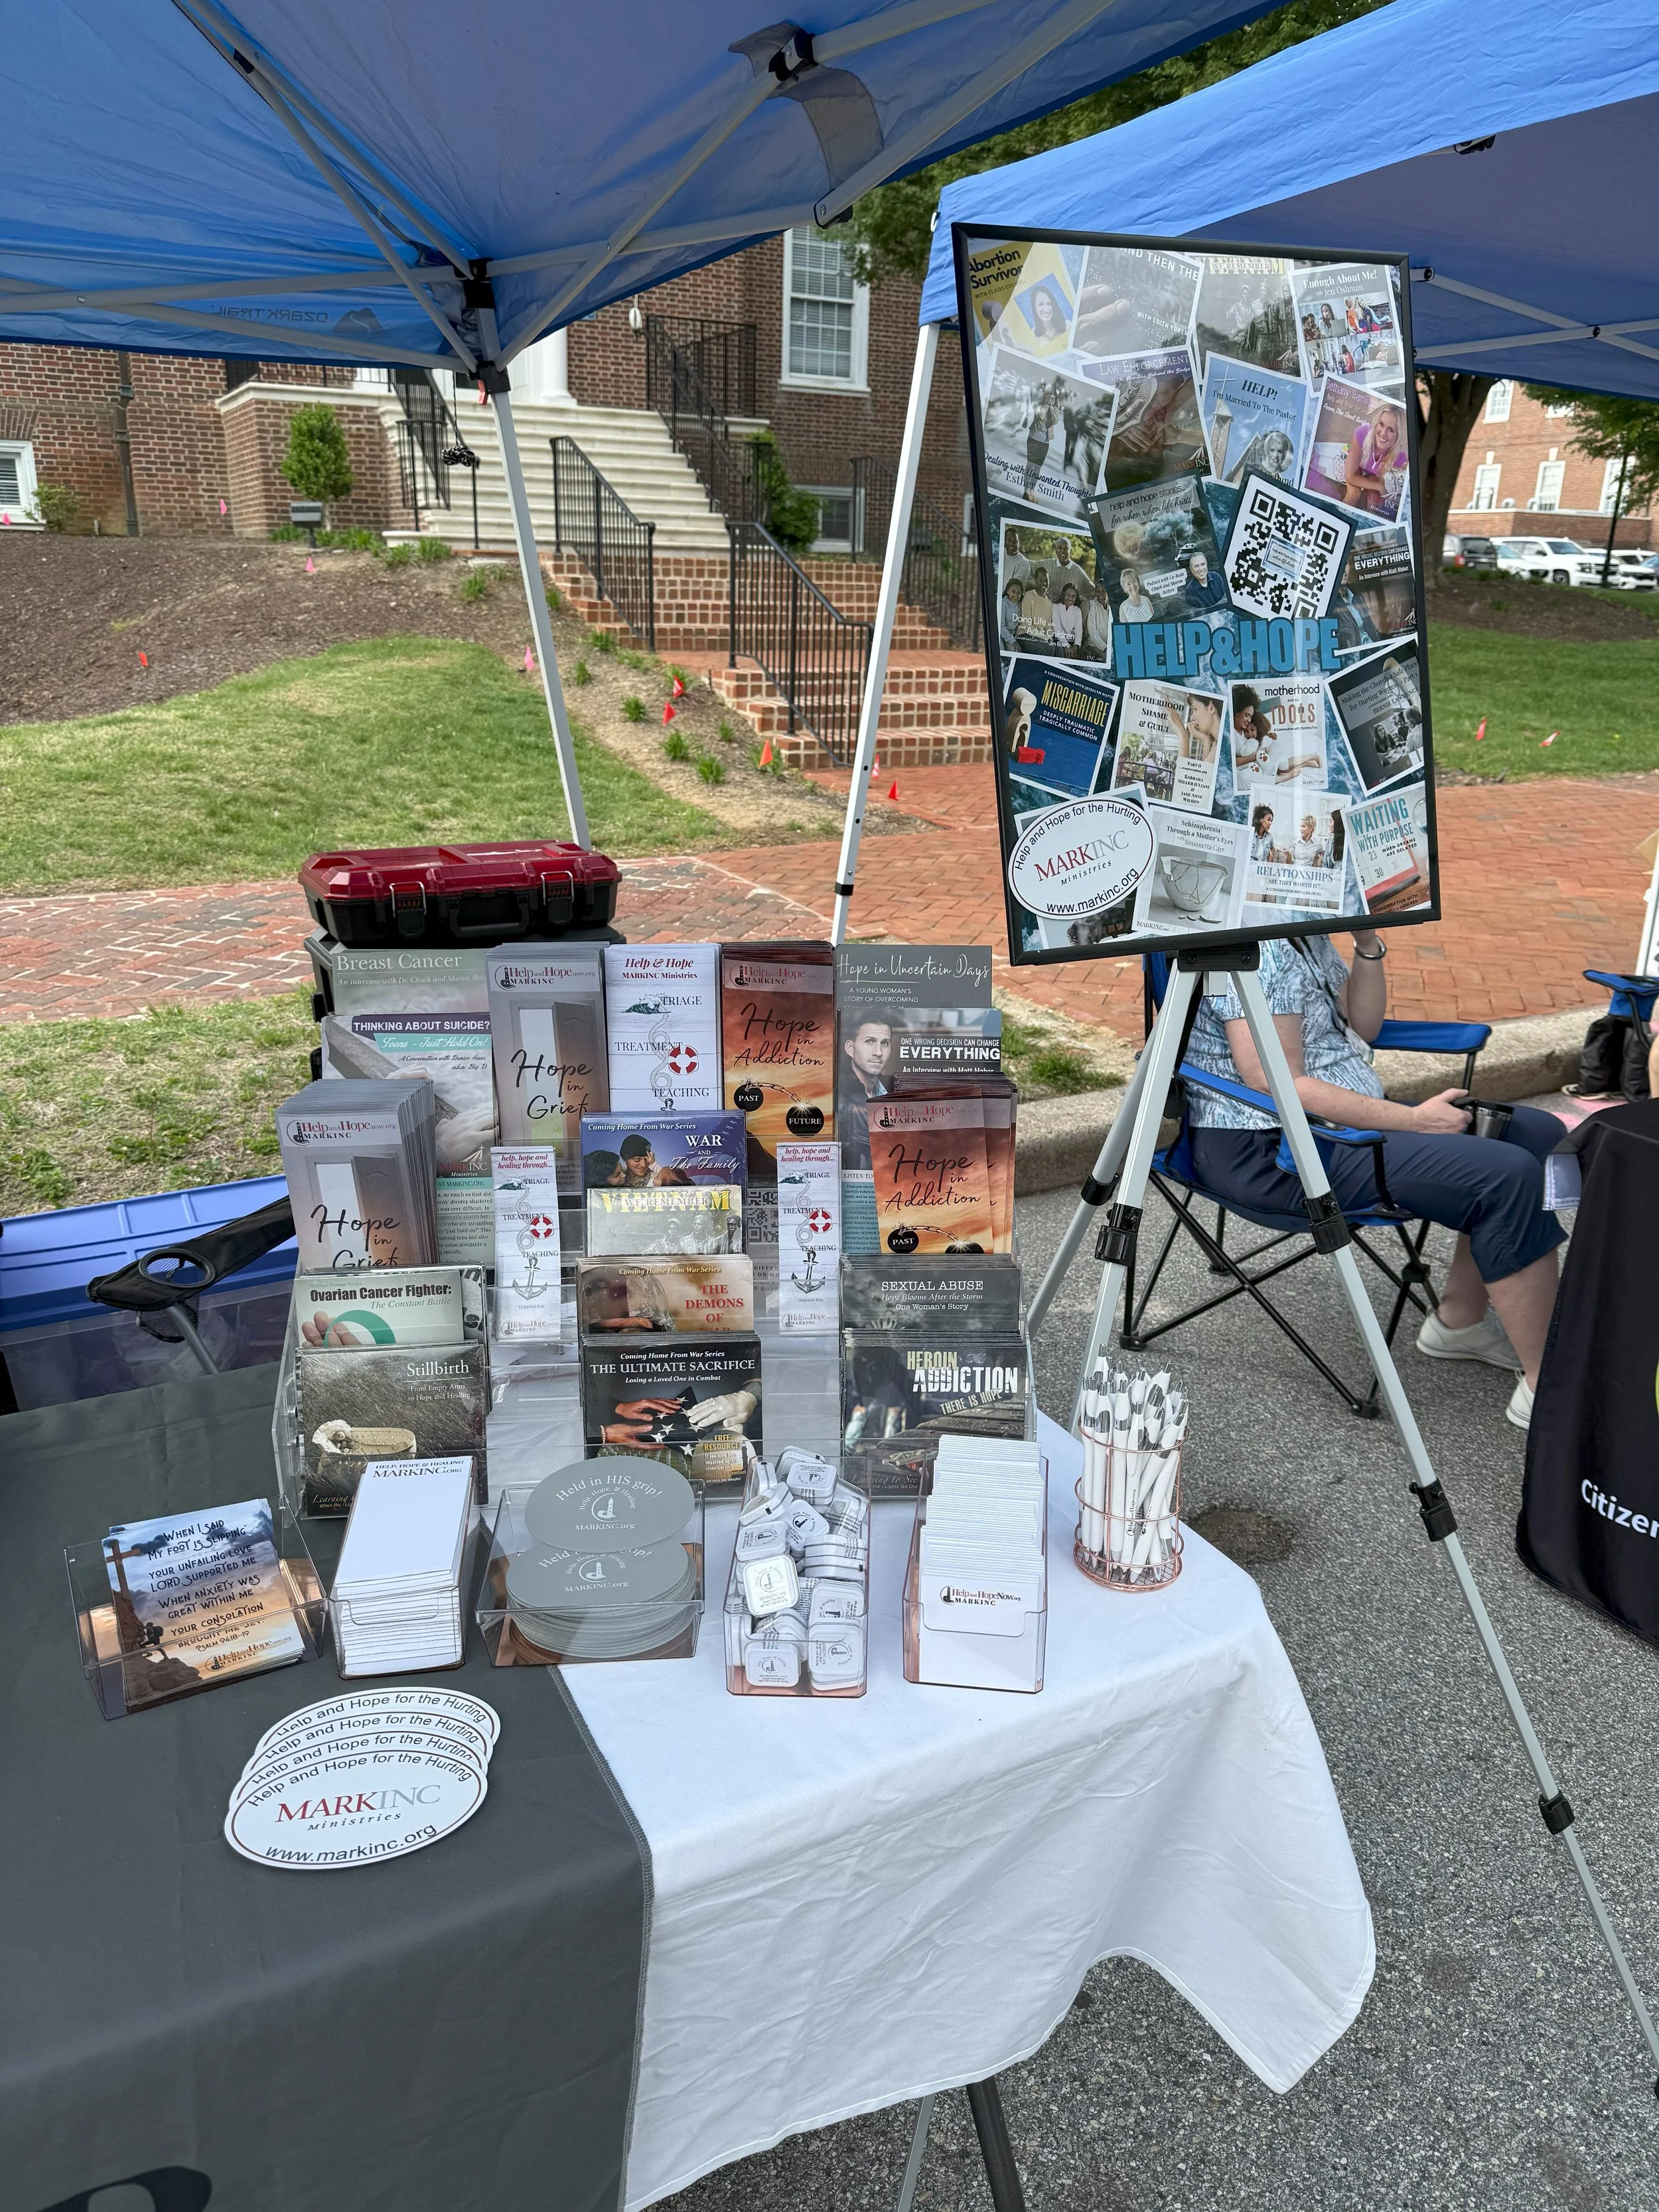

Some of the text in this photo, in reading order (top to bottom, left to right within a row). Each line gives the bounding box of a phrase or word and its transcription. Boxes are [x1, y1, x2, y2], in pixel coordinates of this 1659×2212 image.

[1303, 270, 1377, 289] Enough About Me!
[1324, 284, 1364, 297] Jen Oshman
[1100, 363, 1119, 376] LAW
[1123, 355, 1189, 373] ENFORCEMENT
[1242, 380, 1277, 400] HELP!
[1213, 390, 1296, 421] I'm Married To The Pastor
[1006, 472, 1064, 501] Esther Smith
[1110, 493, 1158, 511] help and hope
[1354, 551, 1410, 571] EVERYTHING
[1012, 614, 1046, 626] Doing Life
[1027, 627, 1074, 640] Adult Children
[1265, 684, 1319, 697] motherhood
[1041, 680, 1110, 727] MISCARRIAGE
[1043, 710, 1095, 734] DEEPLY TRAUMATIC
[1271, 703, 1316, 725] IDOLS
[1039, 715, 1098, 741] TRAGICALLY COMMON
[1350, 798, 1409, 836] WAITING
[1015, 803, 1141, 870] Help and Hope for the Hurting
[1358, 822, 1413, 853] WITH PURPOSE
[1034, 830, 1129, 881] MARKINC
[1382, 844, 1396, 853] WHEN
[1397, 843, 1417, 854] DELAYED
[1257, 865, 1333, 882] RELATIONSHIPS
[1047, 867, 1139, 913] www.markinc.org
[336, 954, 462, 971] Breast Cancer
[625, 958, 693, 970] Help & Hope
[837, 954, 990, 986] Hope in Uncertain Days
[660, 996, 702, 1005] TRIAGE
[354, 1021, 490, 1031] THINKING ABOUT SUICIDE?
[741, 1003, 822, 1053] Hope
[615, 1041, 683, 1052] TREATMENT
[798, 1035, 814, 1045] in
[734, 1041, 825, 1068] Addiction
[900, 1047, 1000, 1060] EVERYTHING
[511, 1049, 593, 1098] Hope
[567, 1081, 584, 1092] in
[653, 1088, 709, 1098] TEACHING
[685, 1134, 723, 1147] WAR
[601, 1189, 731, 1214] VIETNAM
[626, 1197, 709, 1207] WE REMEMBER
[310, 1284, 451, 1302] Ovarian Cancer Fighter:
[701, 1284, 728, 1295] THE
[881, 1281, 983, 1291] SEXUAL ABUSE
[685, 1298, 744, 1309] DEMONS
[705, 1313, 723, 1323] OF
[407, 1360, 469, 1376] Stillbirth
[590, 1360, 755, 1374] THE ULTIMATE SACRIFICE
[907, 1351, 958, 1370] HEROIN
[912, 1366, 1018, 1393] ADDICTION
[940, 1388, 1003, 1416] THERE IS HOPE
[373, 1467, 462, 1477] MARKINC.ORG
[555, 1475, 662, 1501] Held in HIS grip!
[163, 1525, 195, 1542] WHEN
[201, 1520, 224, 1534] SAID
[248, 1751, 472, 1807] Help and Hope for the Hurting
[273, 1785, 441, 1824] MARKINC
[307, 1812, 402, 1831] Ministries
[265, 1823, 437, 1863] www.markinc.org
